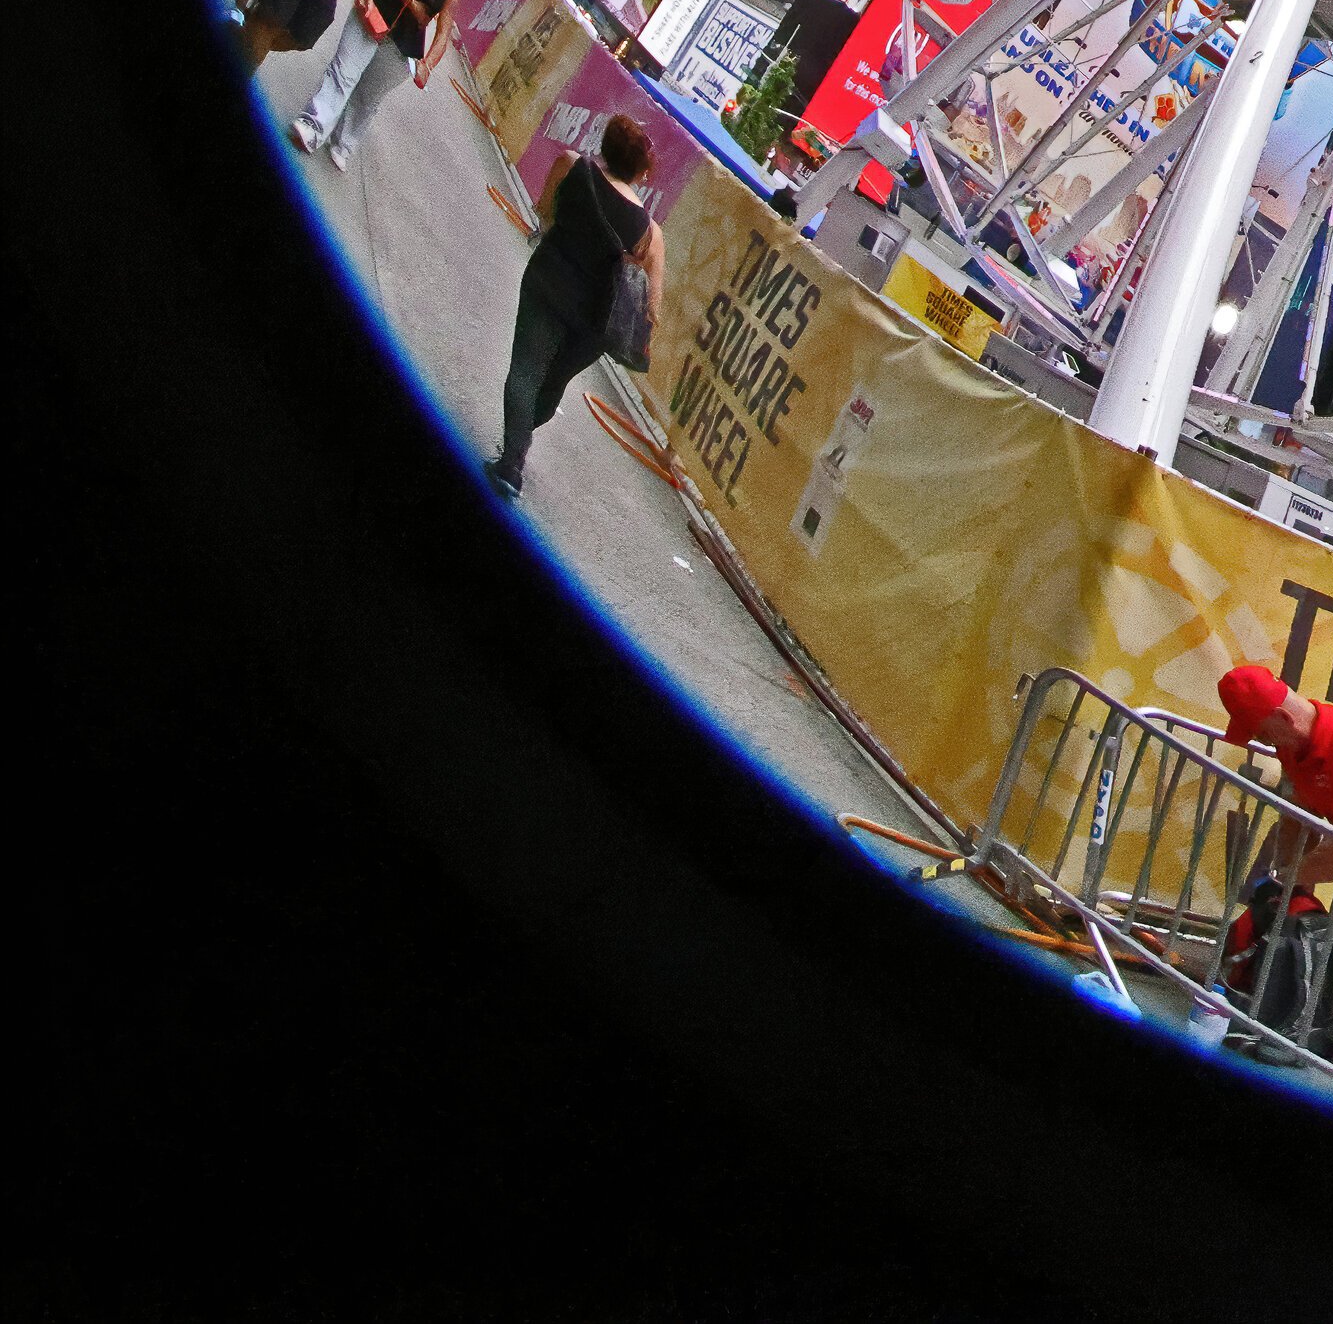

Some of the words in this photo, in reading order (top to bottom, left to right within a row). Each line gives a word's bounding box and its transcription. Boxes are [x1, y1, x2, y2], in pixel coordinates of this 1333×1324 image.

[715, 2, 754, 41] SUPPORT
[1034, 68, 1064, 99] ON
[1127, 119, 1151, 143] IN
[731, 229, 822, 350] TIMES
[938, 285, 974, 315] TIMES
[925, 292, 968, 327] SQUARE
[696, 294, 806, 446] SQUARE
[670, 353, 753, 509] WHEEL
